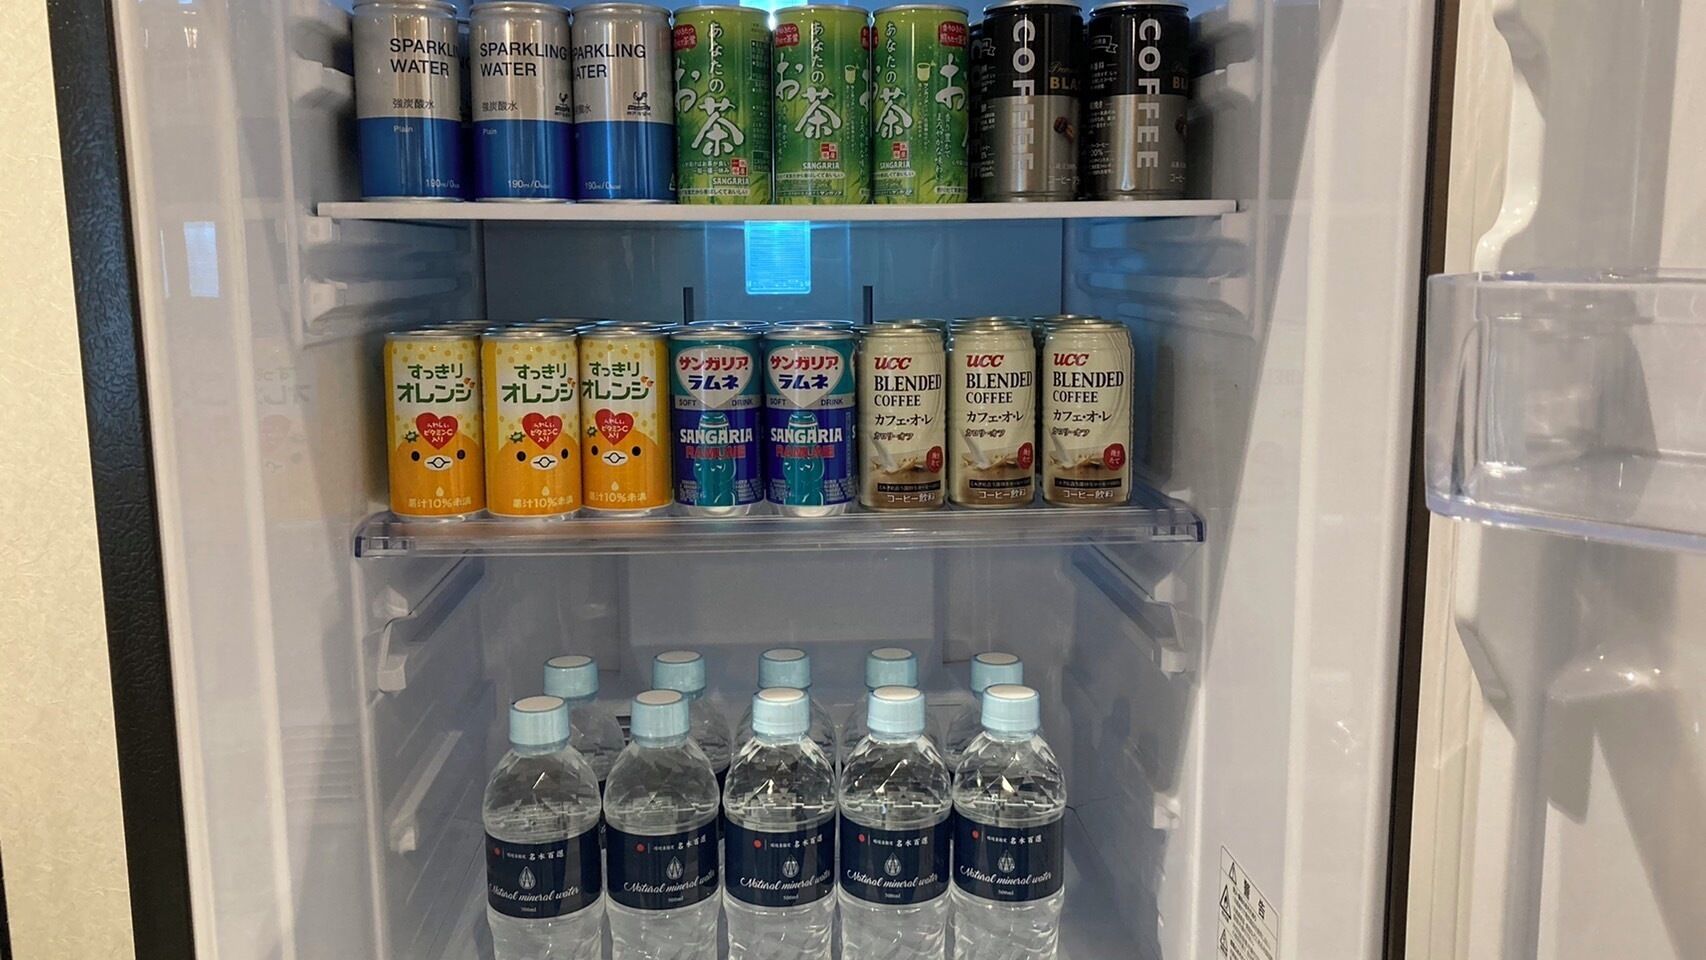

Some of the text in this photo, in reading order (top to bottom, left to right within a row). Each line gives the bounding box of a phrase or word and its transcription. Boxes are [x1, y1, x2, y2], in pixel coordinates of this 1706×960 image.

[480, 42, 567, 60] SPARKLING
[571, 43, 646, 60] PARKLING
[709, 21, 724, 92] あなたの
[811, 21, 825, 83] あなたの
[886, 22, 897, 83] あなたの
[390, 59, 449, 77] WATER
[480, 62, 537, 77] WATER
[576, 64, 607, 80] ATER
[776, 52, 842, 140] お茶
[1012, 19, 1036, 170] COFFEE
[1136, 18, 1162, 168] COFFEE
[392, 97, 435, 110] 強炭酸水
[393, 125, 413, 133] Plain
[802, 160, 841, 169] SANGARIA
[879, 160, 911, 169] SANGARIA
[712, 177, 749, 186] SANGARIA
[589, 361, 640, 377] すっきり
[679, 355, 749, 371] サンガリア
[770, 355, 839, 371] サンガリア
[407, 363, 463, 380] すっきり
[514, 363, 567, 380] すっきり
[1053, 370, 1124, 388] BLENDED
[688, 374, 739, 390] ラムネ
[778, 373, 829, 390] ラムネ
[874, 374, 942, 392] BLENDED
[966, 371, 1033, 389] BLENDED
[397, 382, 471, 403] オレンジ
[502, 382, 573, 404] オレンジ
[582, 379, 649, 400] オレンジ
[966, 391, 1013, 404] COFFEE
[1052, 390, 1098, 403] COFFEE
[679, 398, 753, 407] SOFT DRINK
[770, 398, 844, 407] SOFT DRINK
[874, 394, 921, 407] COFFEE
[424, 428, 454, 437] ビタミンC
[530, 428, 558, 437] ビタミンC
[601, 424, 629, 433] ビタミンC
[680, 427, 752, 444] SANGARIA
[771, 427, 843, 444] SANGARIA
[538, 435, 550, 443] 入り
[1063, 490, 1114, 499] コーヒー飲料
[740, 876, 781, 891] Natural
[781, 875, 813, 890] mineral
[846, 869, 883, 887] Natural
[883, 875, 917, 888] mineral
[960, 865, 997, 884] Natural
[996, 874, 1032, 885] mineral
[518, 889, 553, 902] mineral
[554, 885, 581, 901] water
[624, 881, 666, 894] Natural
[665, 879, 698, 892] mineral
